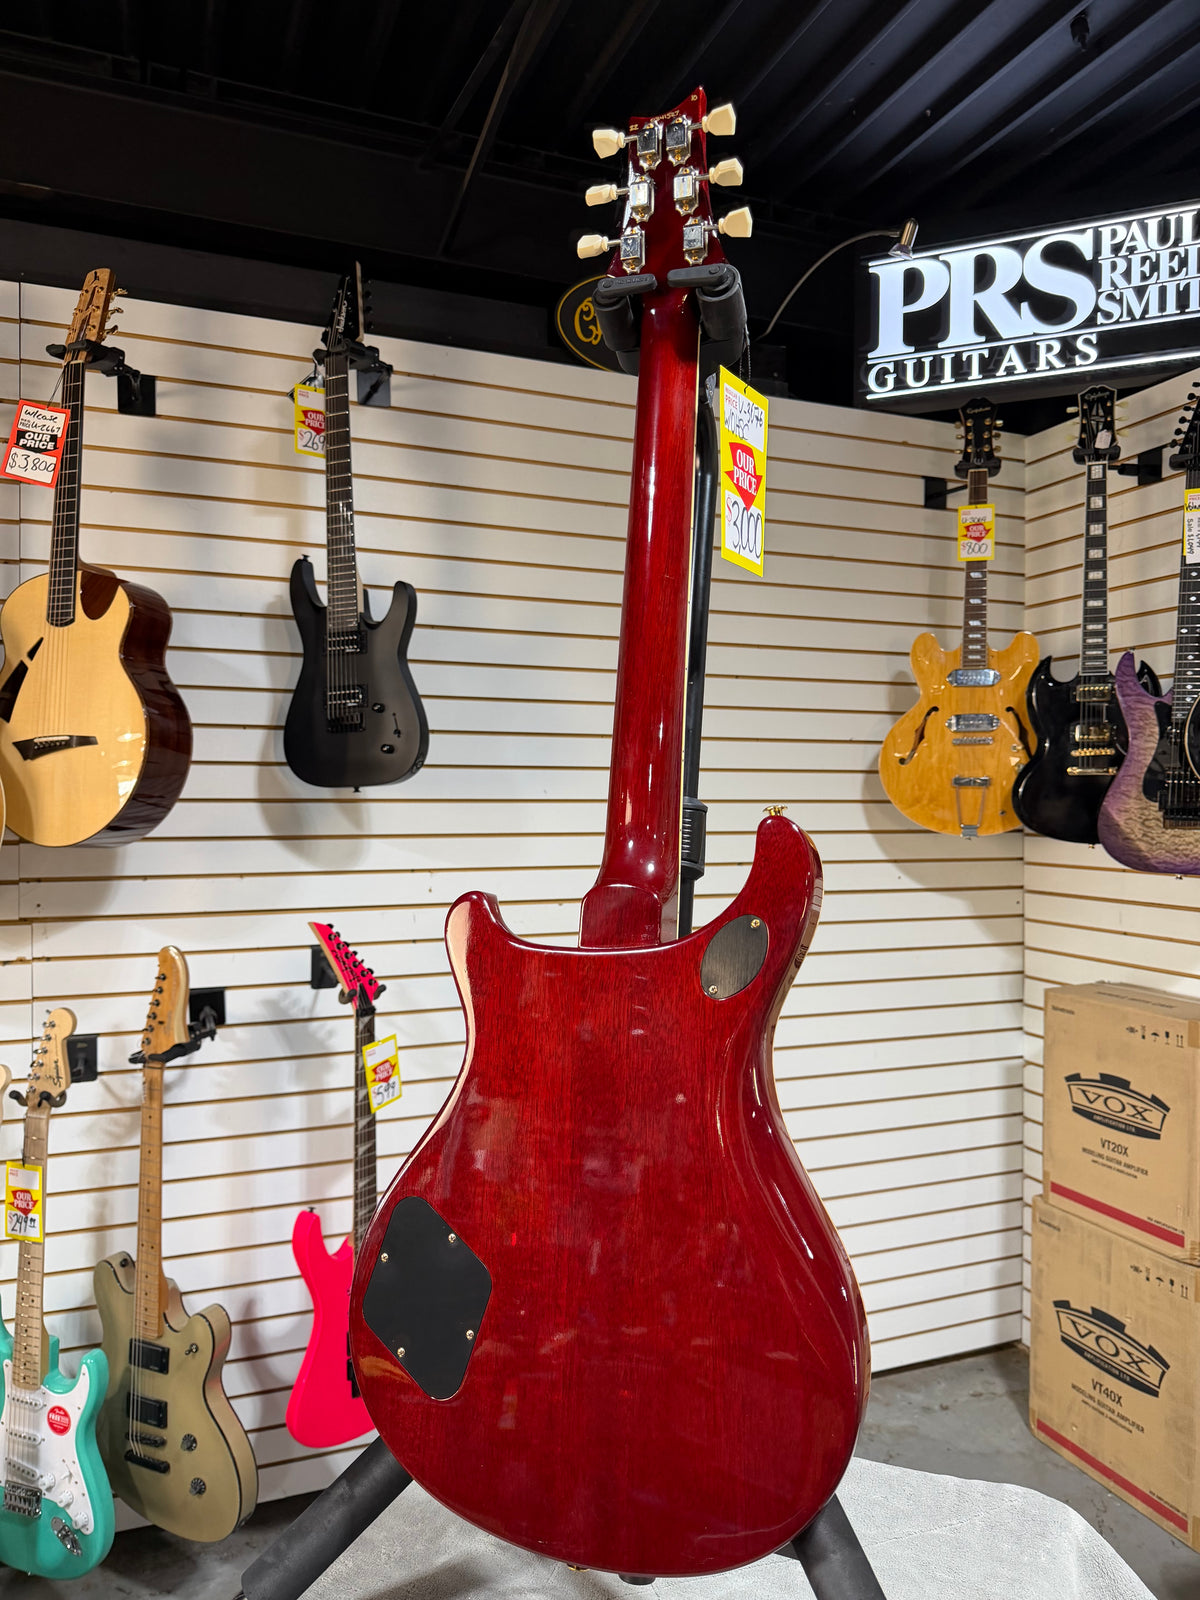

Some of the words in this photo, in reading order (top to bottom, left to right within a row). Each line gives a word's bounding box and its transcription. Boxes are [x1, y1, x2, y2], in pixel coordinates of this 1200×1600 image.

[1097, 210, 1200, 260] PAUL
[868, 228, 1096, 359] PRS
[866, 333, 1099, 394] GUITARS
[307, 411, 325, 422] OUR
[19, 438, 56, 450] PRICE
[25, 432, 51, 441] OUR
[736, 449, 755, 476] OUR
[733, 470, 757, 496] PRICE
[1077, 1087, 1153, 1124] VOX
[1100, 1137, 1129, 1158] VT20X
[14, 1199, 34, 1209] PRICE
[16, 1191, 32, 1201] OUR
[1066, 1316, 1151, 1378] VOX
[1091, 1378, 1123, 1408] VT40X
